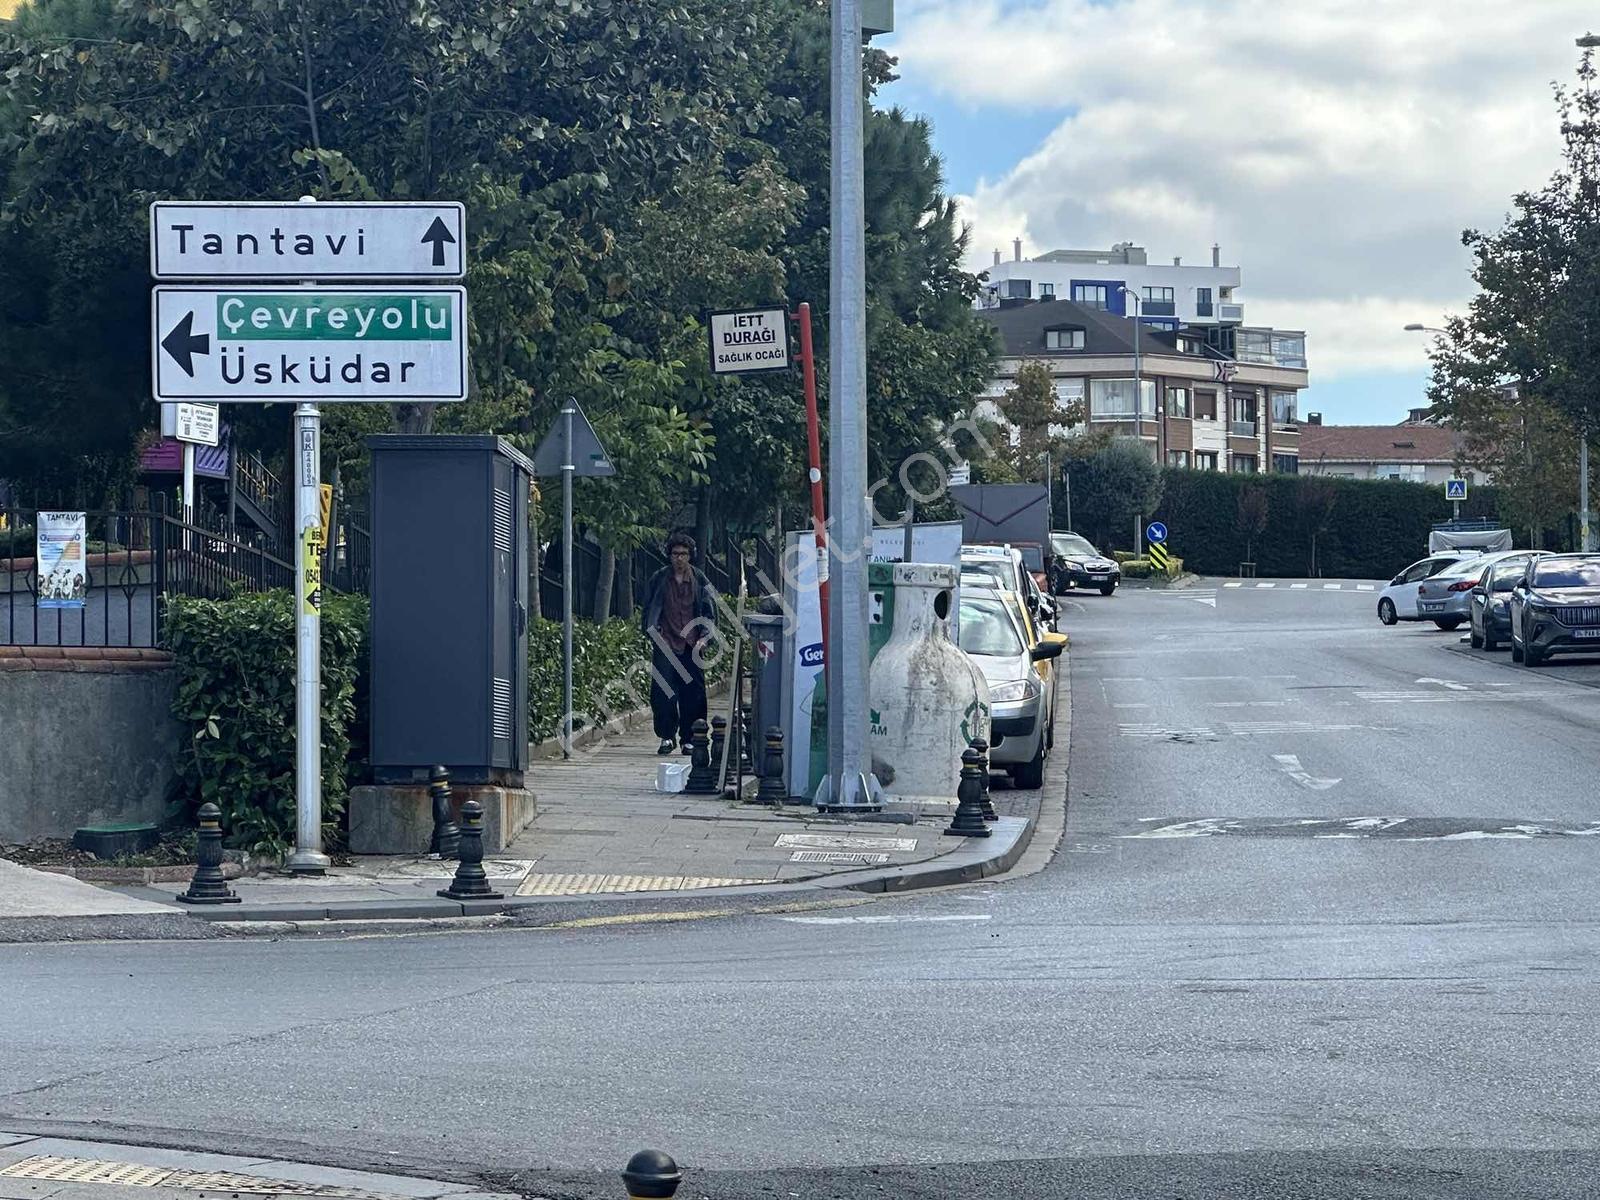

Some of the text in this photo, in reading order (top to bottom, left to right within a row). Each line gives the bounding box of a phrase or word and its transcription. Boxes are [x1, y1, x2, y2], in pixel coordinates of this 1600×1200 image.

[171, 224, 365, 255] Tantavi
[221, 297, 446, 338] Çevreyolu
[723, 328, 776, 344] DURAĞI
[220, 346, 416, 384] Üsküdar
[718, 348, 784, 363] SAĞLIK OCAĞI
